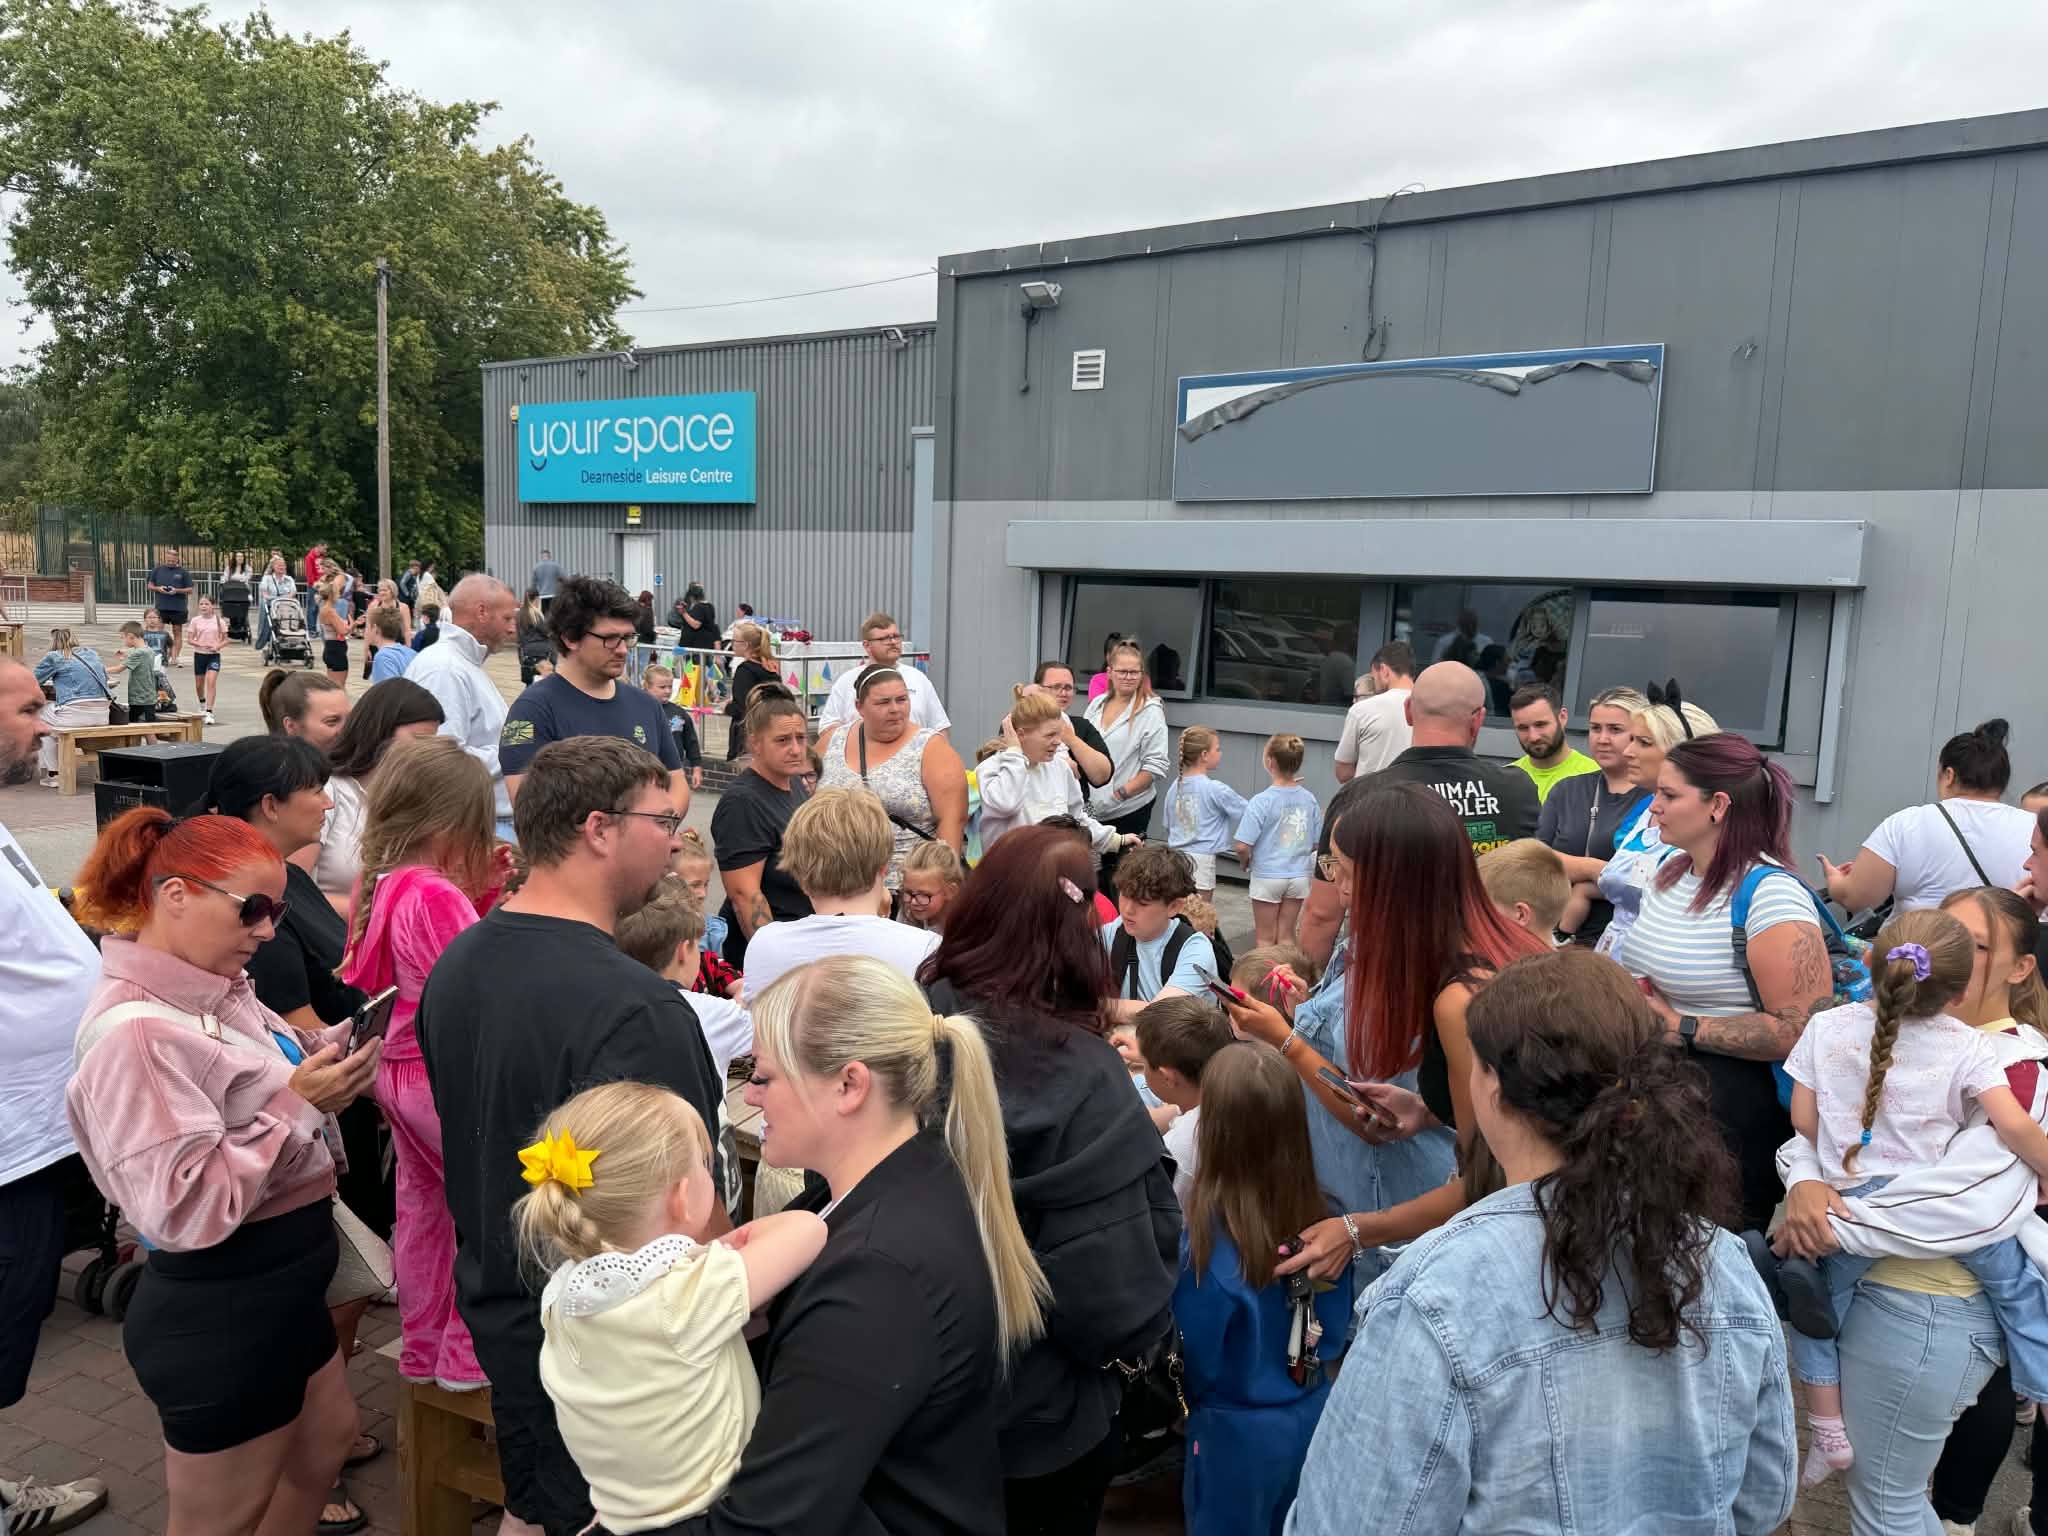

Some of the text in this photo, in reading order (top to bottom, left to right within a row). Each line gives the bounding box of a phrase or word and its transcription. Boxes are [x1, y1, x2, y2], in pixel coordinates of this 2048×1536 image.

[580, 467, 734, 485] Dearneside Leisure Centre
[1449, 797, 1501, 817] DLER
